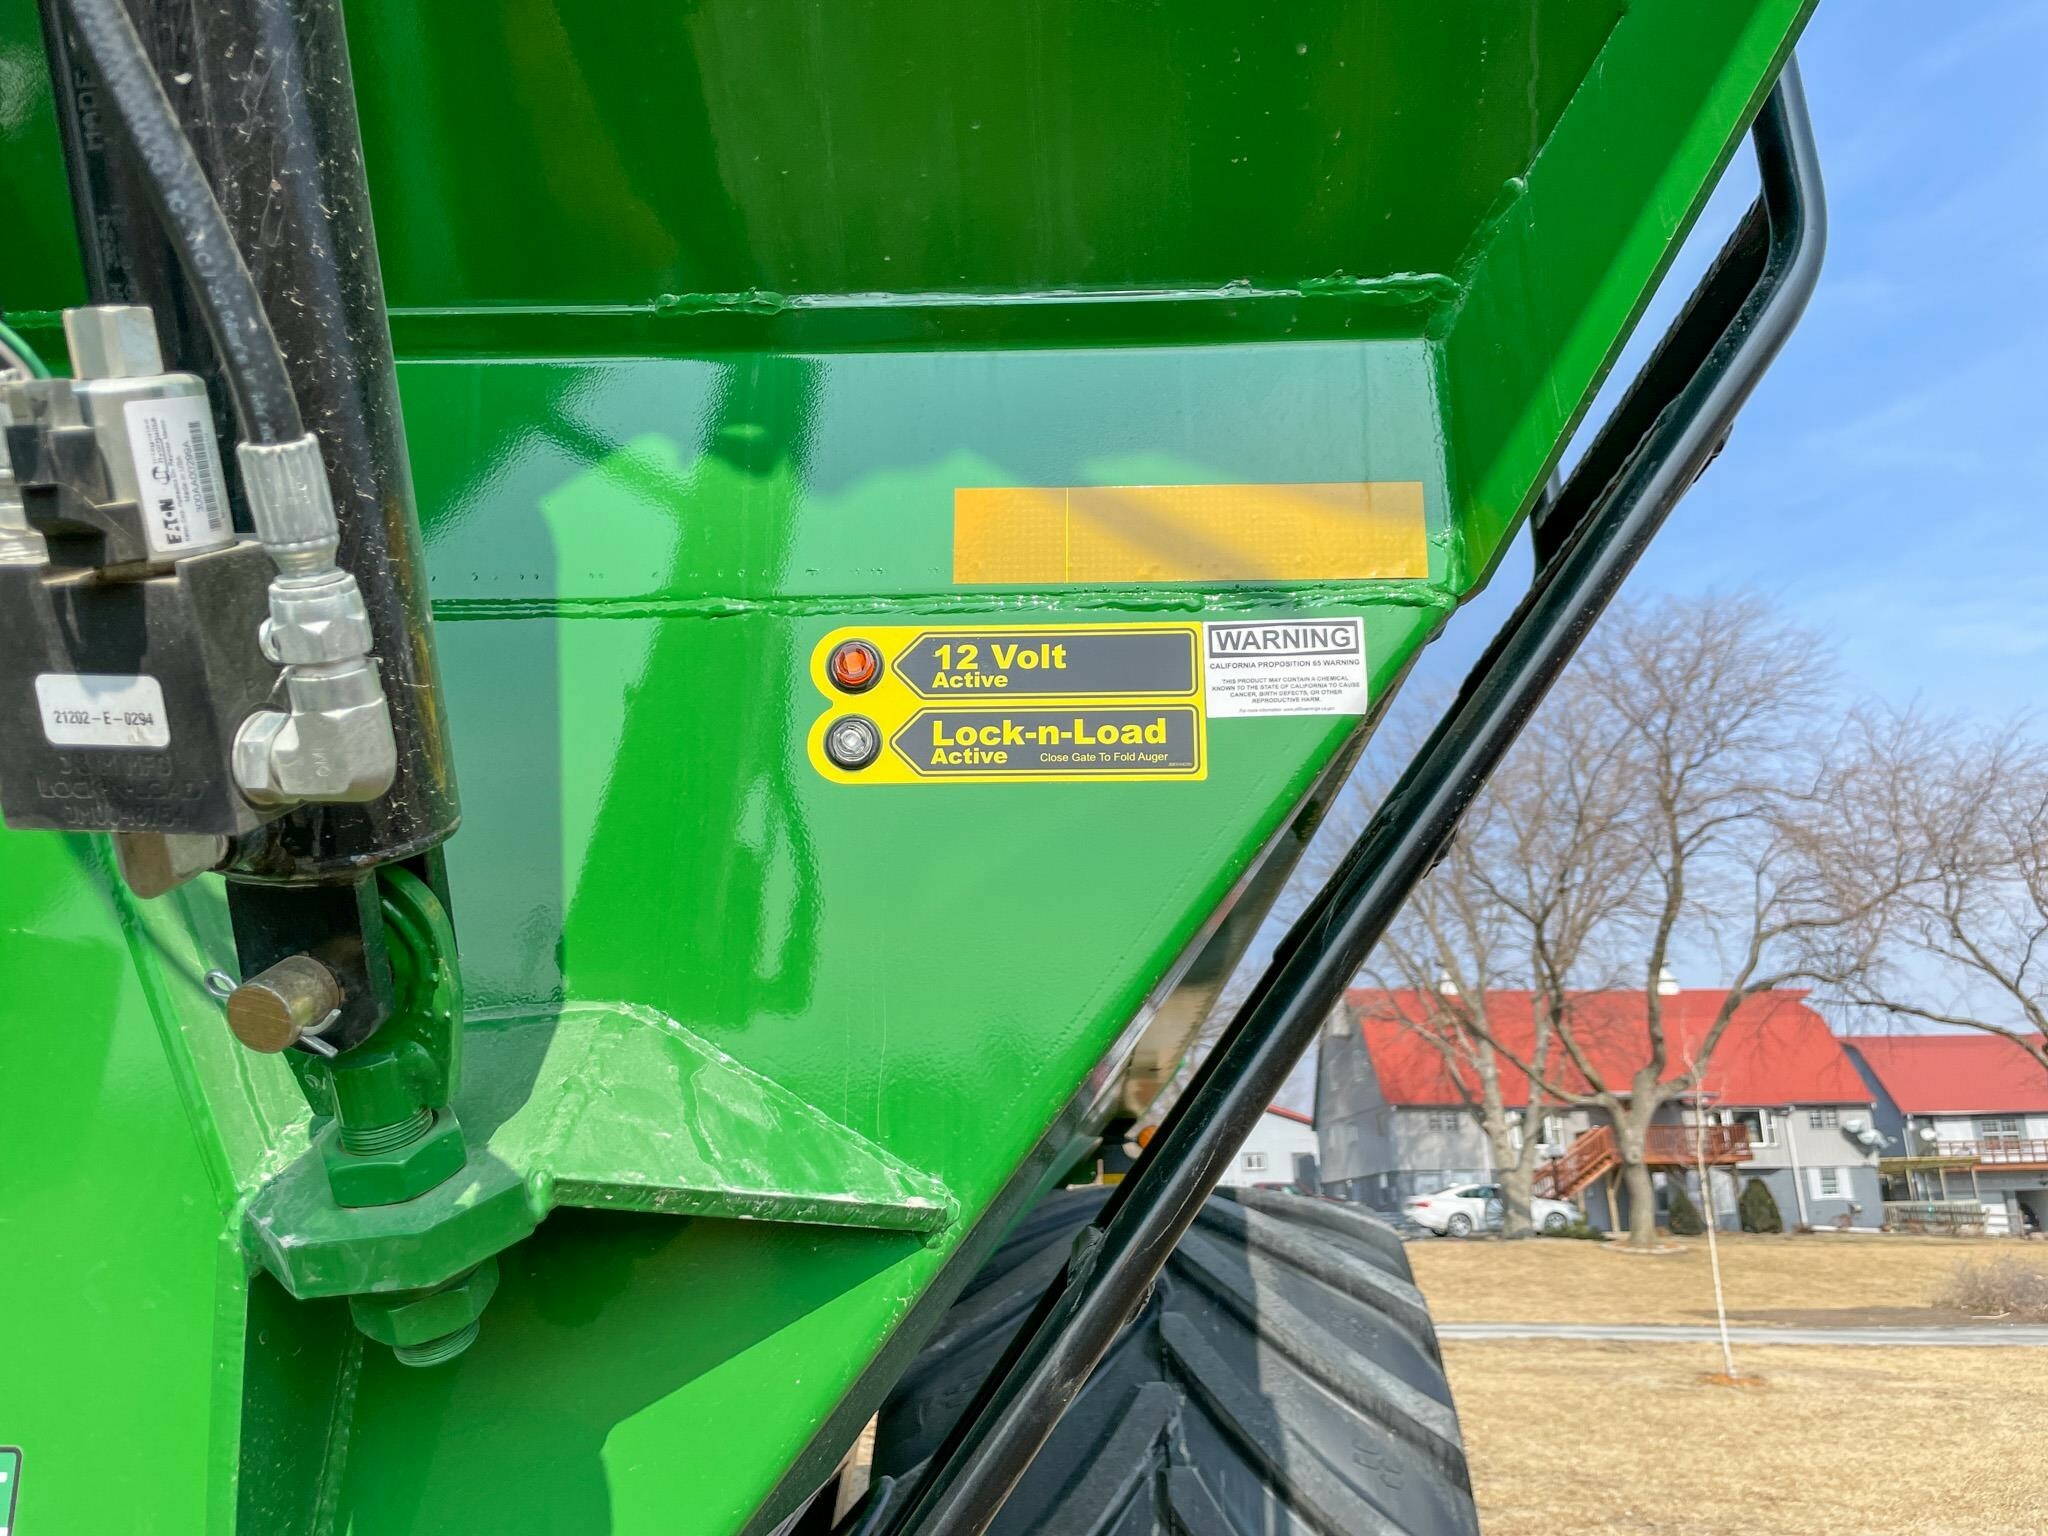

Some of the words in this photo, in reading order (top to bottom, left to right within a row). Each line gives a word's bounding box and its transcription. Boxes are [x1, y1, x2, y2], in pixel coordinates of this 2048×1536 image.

[1216, 627, 1351, 651] WARNING
[933, 644, 979, 670] 12
[991, 643, 1067, 670] Volt
[1258, 660, 1310, 668] PROPOSITION
[1323, 658, 1360, 666] WARNING
[932, 671, 1009, 689] Active
[53, 711, 154, 726] 21202-E-0294
[932, 718, 1167, 746] Lock-n-Load
[930, 747, 1008, 765] Active
[1040, 752, 1069, 762] Close
[1071, 752, 1097, 762] Gate
[1098, 752, 1111, 762] To
[1113, 752, 1136, 762] Fold
[1137, 752, 1169, 764] Auger
